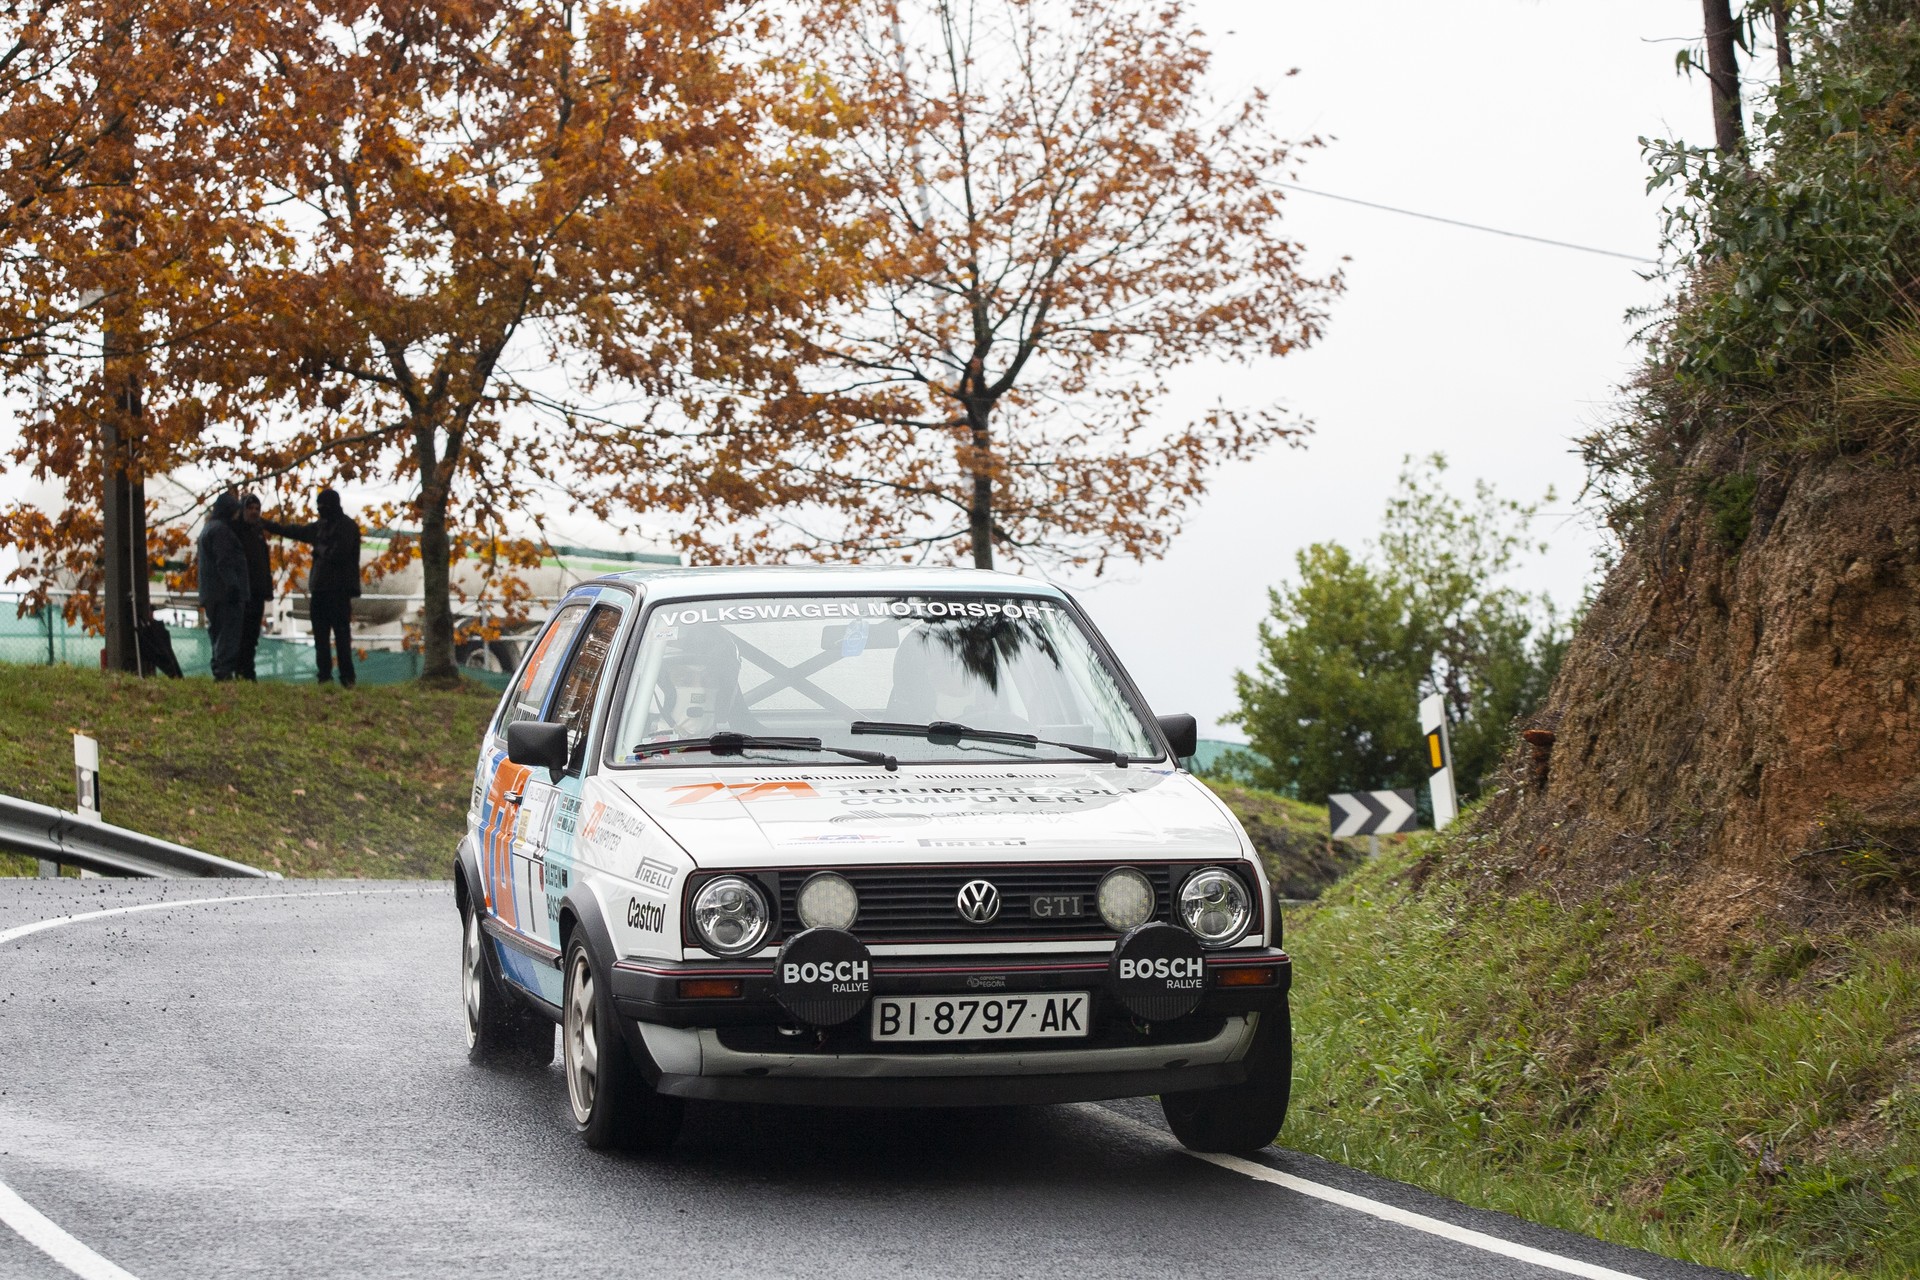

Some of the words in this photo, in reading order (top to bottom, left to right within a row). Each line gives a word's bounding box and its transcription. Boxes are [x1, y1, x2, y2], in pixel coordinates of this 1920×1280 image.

[660, 603, 860, 626] VOLKSWAGEN
[868, 602, 1055, 621] MOTORSPORT
[828, 786, 1026, 797] TRIUMPH
[840, 795, 1085, 806] COMPUTER
[917, 838, 1028, 848] PIRELLI
[634, 855, 679, 890] PIRELLI
[627, 896, 667, 934] Castrol
[1033, 896, 1081, 919] GTI
[783, 960, 869, 984] BOSCH
[1119, 957, 1203, 980] BOSCH
[831, 981, 870, 994] RALLYE
[1166, 979, 1203, 990] RALLYE
